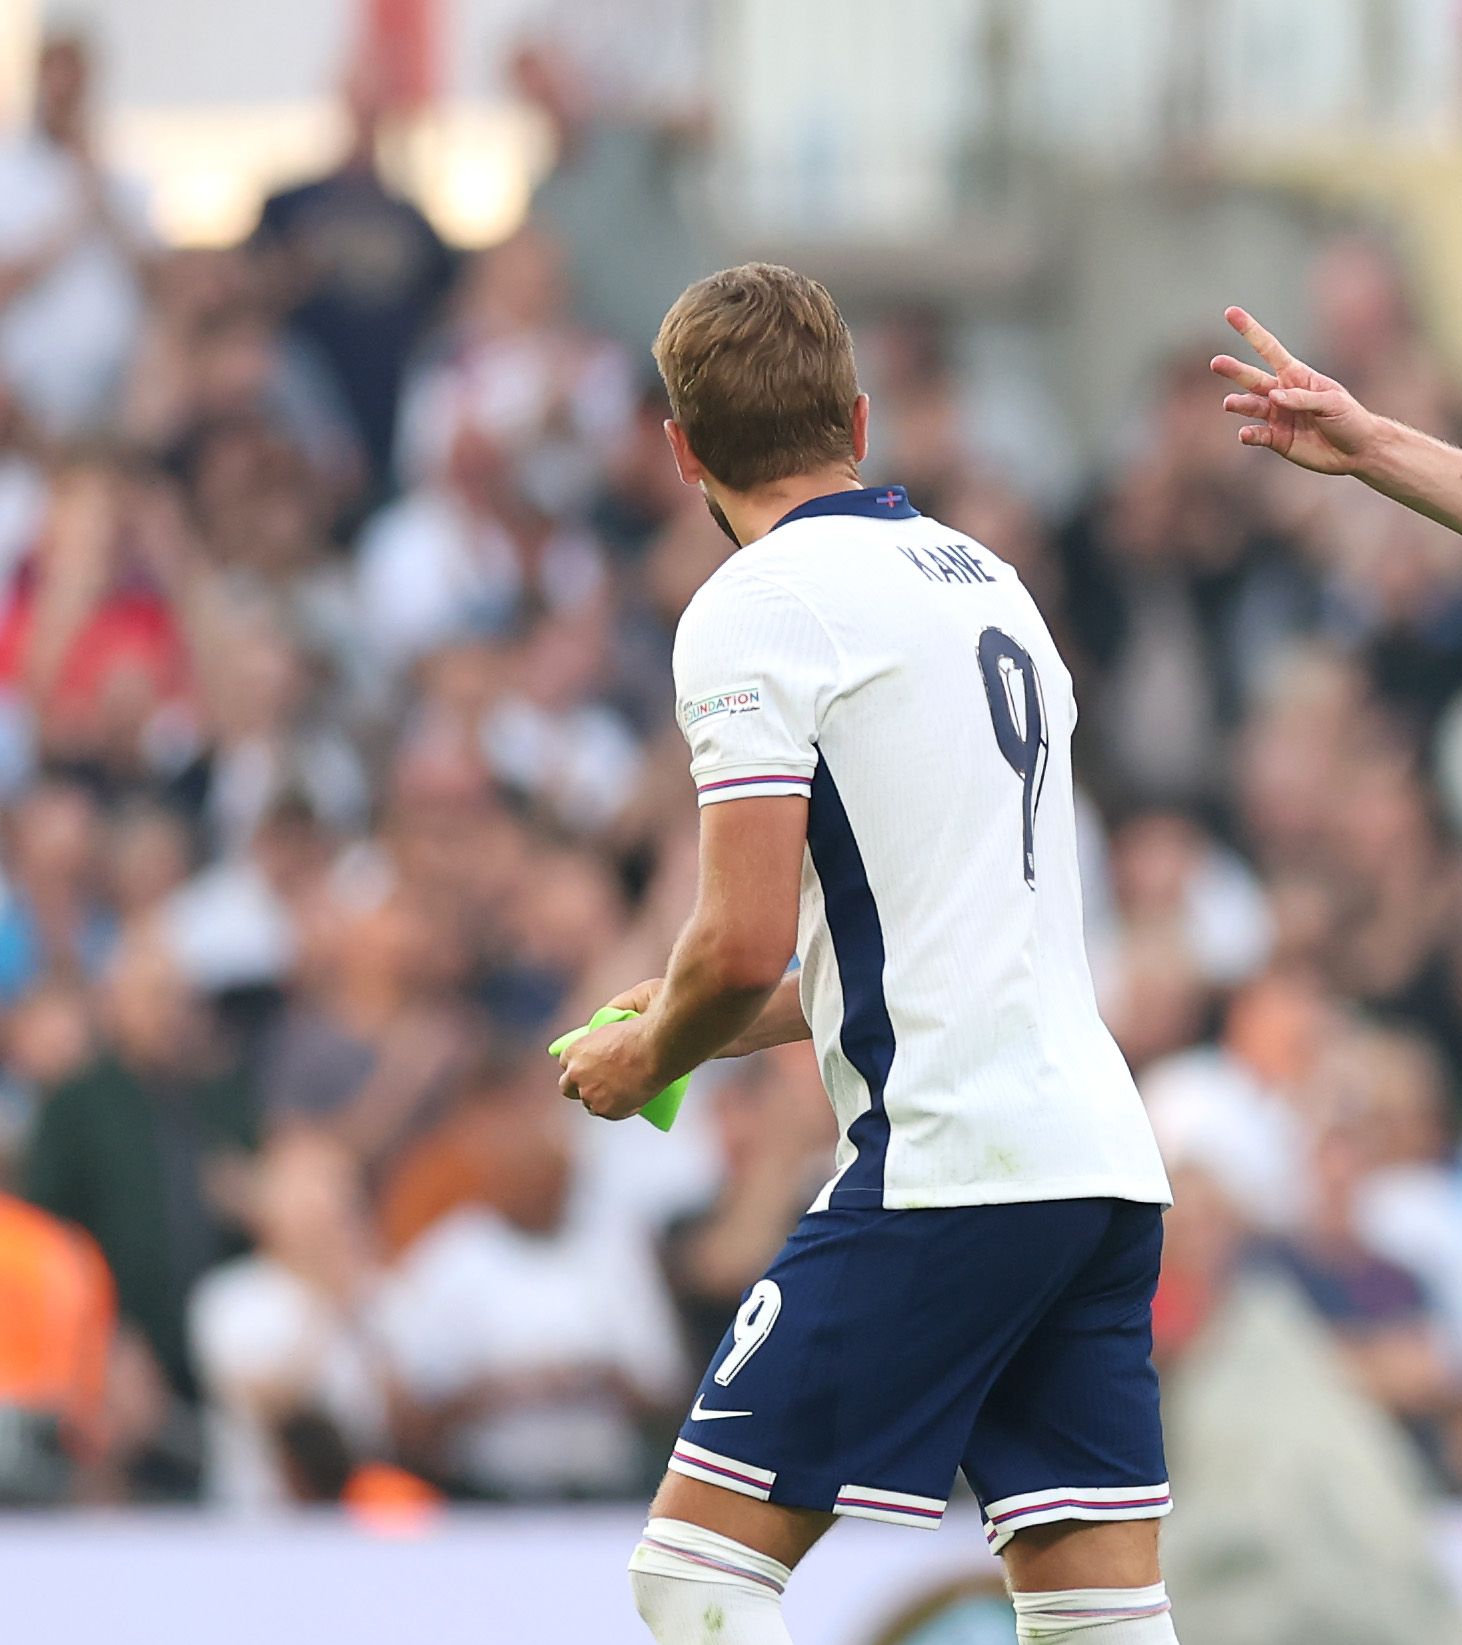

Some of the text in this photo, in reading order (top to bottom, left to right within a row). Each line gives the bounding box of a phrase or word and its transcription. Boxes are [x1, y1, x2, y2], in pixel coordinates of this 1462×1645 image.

[896, 545, 997, 584] KANE
[975, 626, 1049, 891] 9
[713, 1278, 783, 1388] 9
